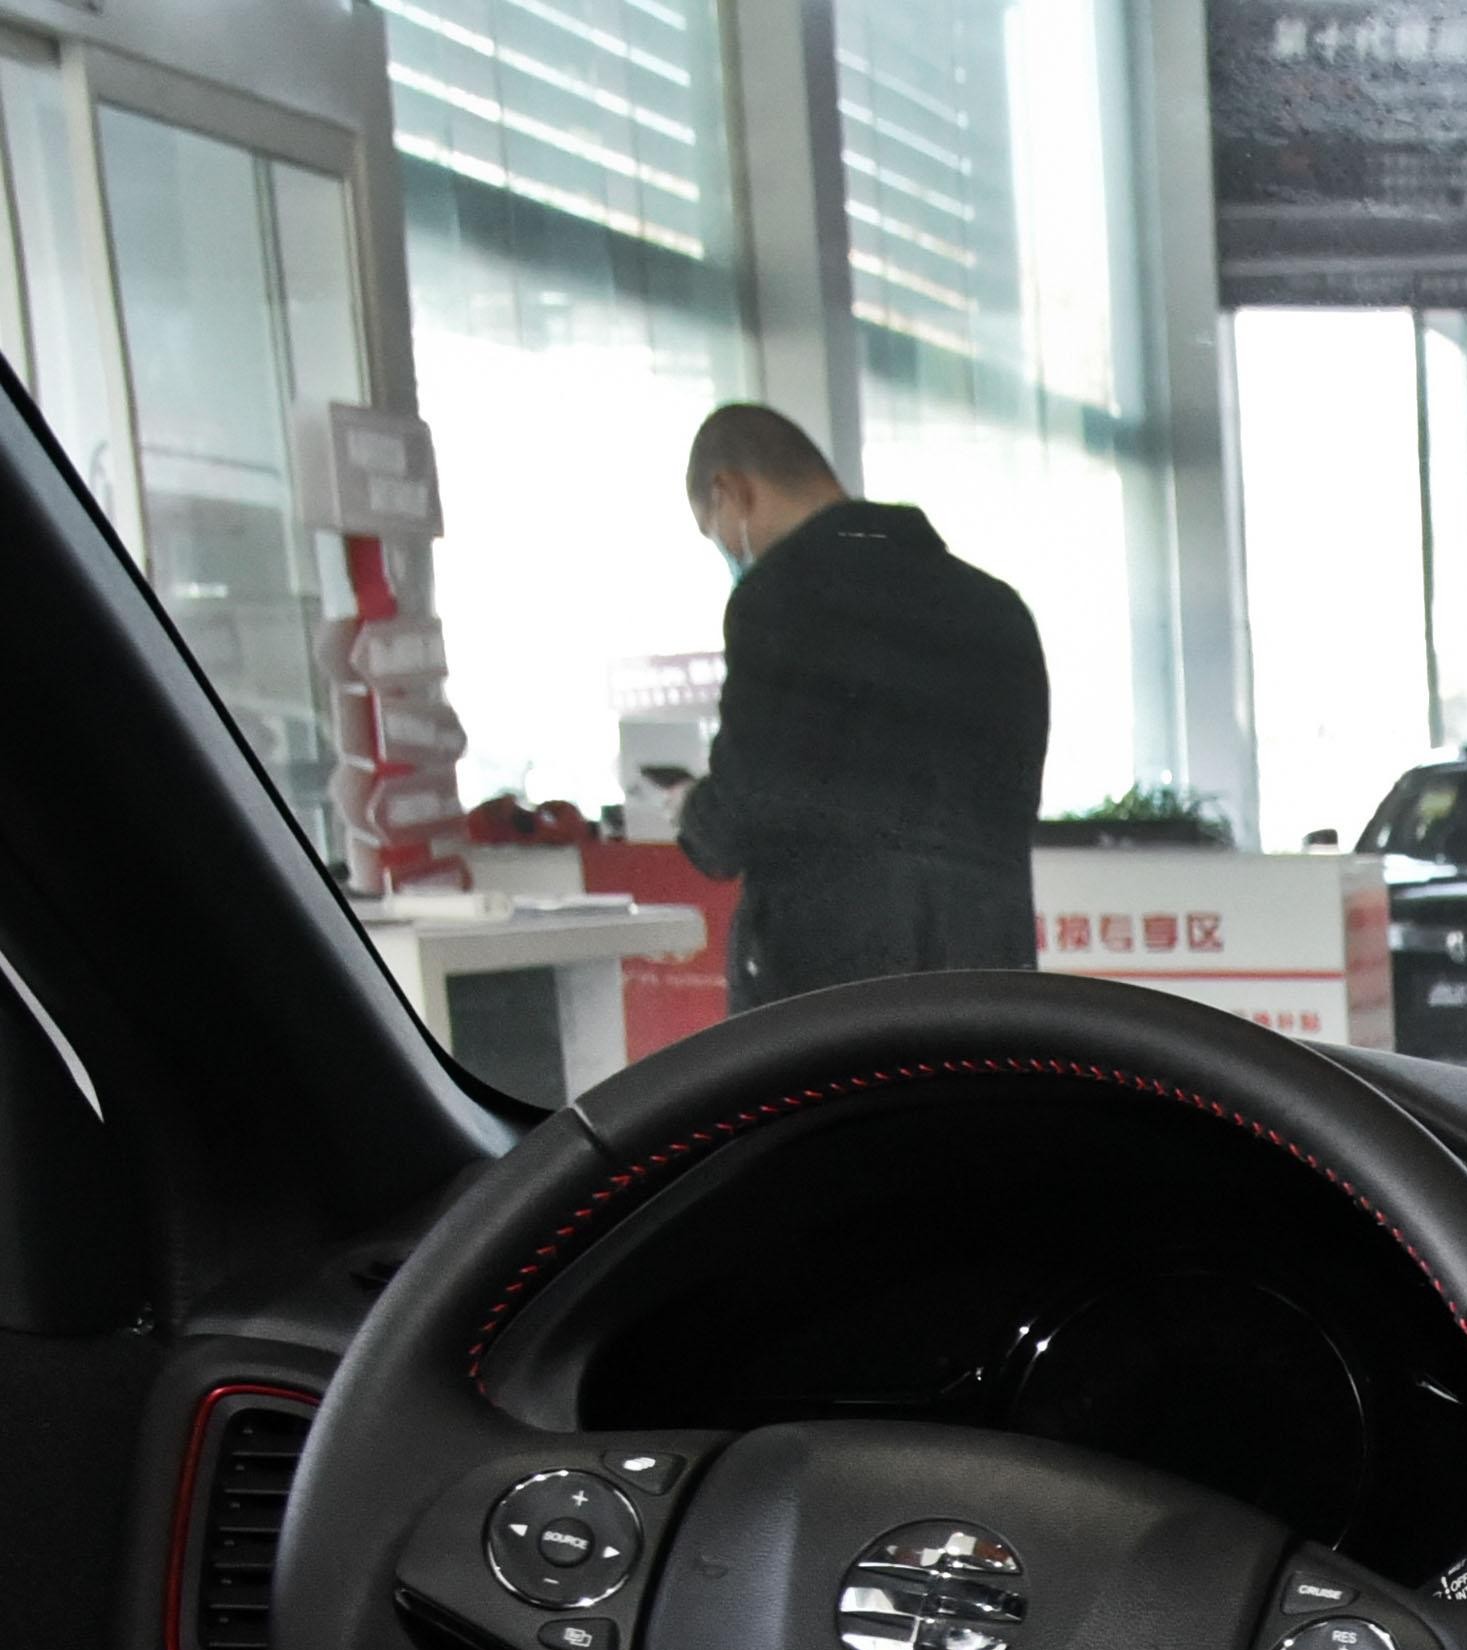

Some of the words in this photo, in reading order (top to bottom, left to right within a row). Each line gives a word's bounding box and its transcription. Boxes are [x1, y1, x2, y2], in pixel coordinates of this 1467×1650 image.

[542, 1530, 589, 1550] SOURCE
[1297, 1584, 1343, 1600] CRUISE
[1331, 1630, 1357, 1645] RES
